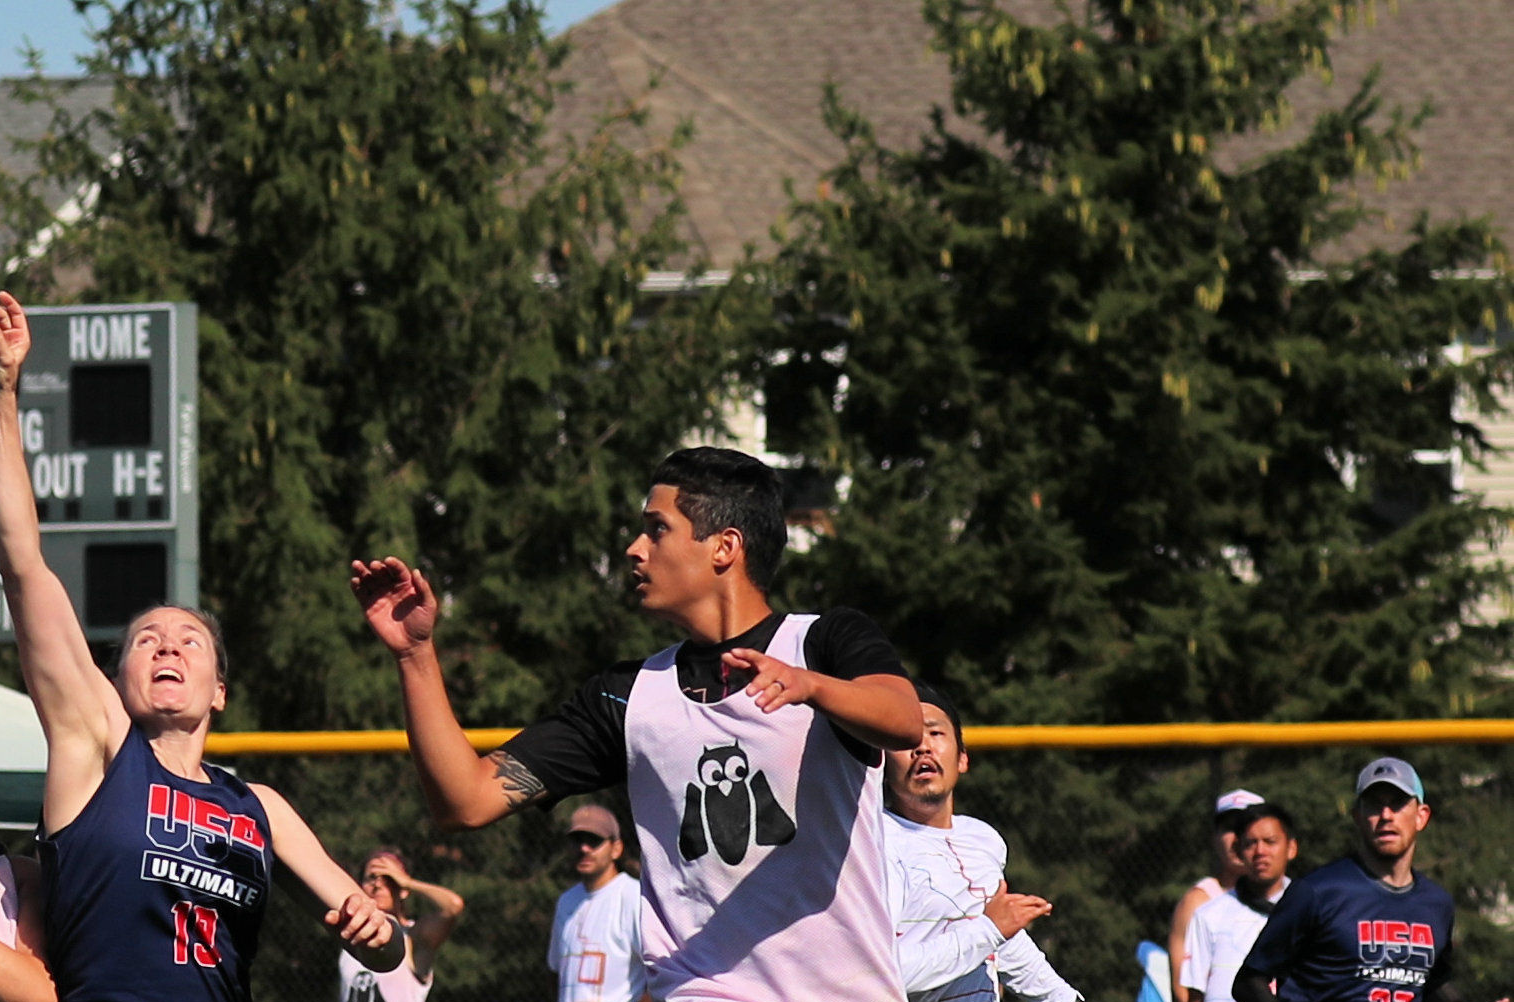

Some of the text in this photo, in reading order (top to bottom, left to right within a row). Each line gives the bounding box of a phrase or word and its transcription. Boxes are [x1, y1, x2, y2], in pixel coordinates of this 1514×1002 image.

[69, 315, 151, 361] HOME
[33, 452, 88, 499] OUT
[112, 451, 164, 496] H-E
[146, 783, 268, 882] USA
[151, 856, 260, 907] ULTIMATE
[1357, 919, 1436, 969] USA
